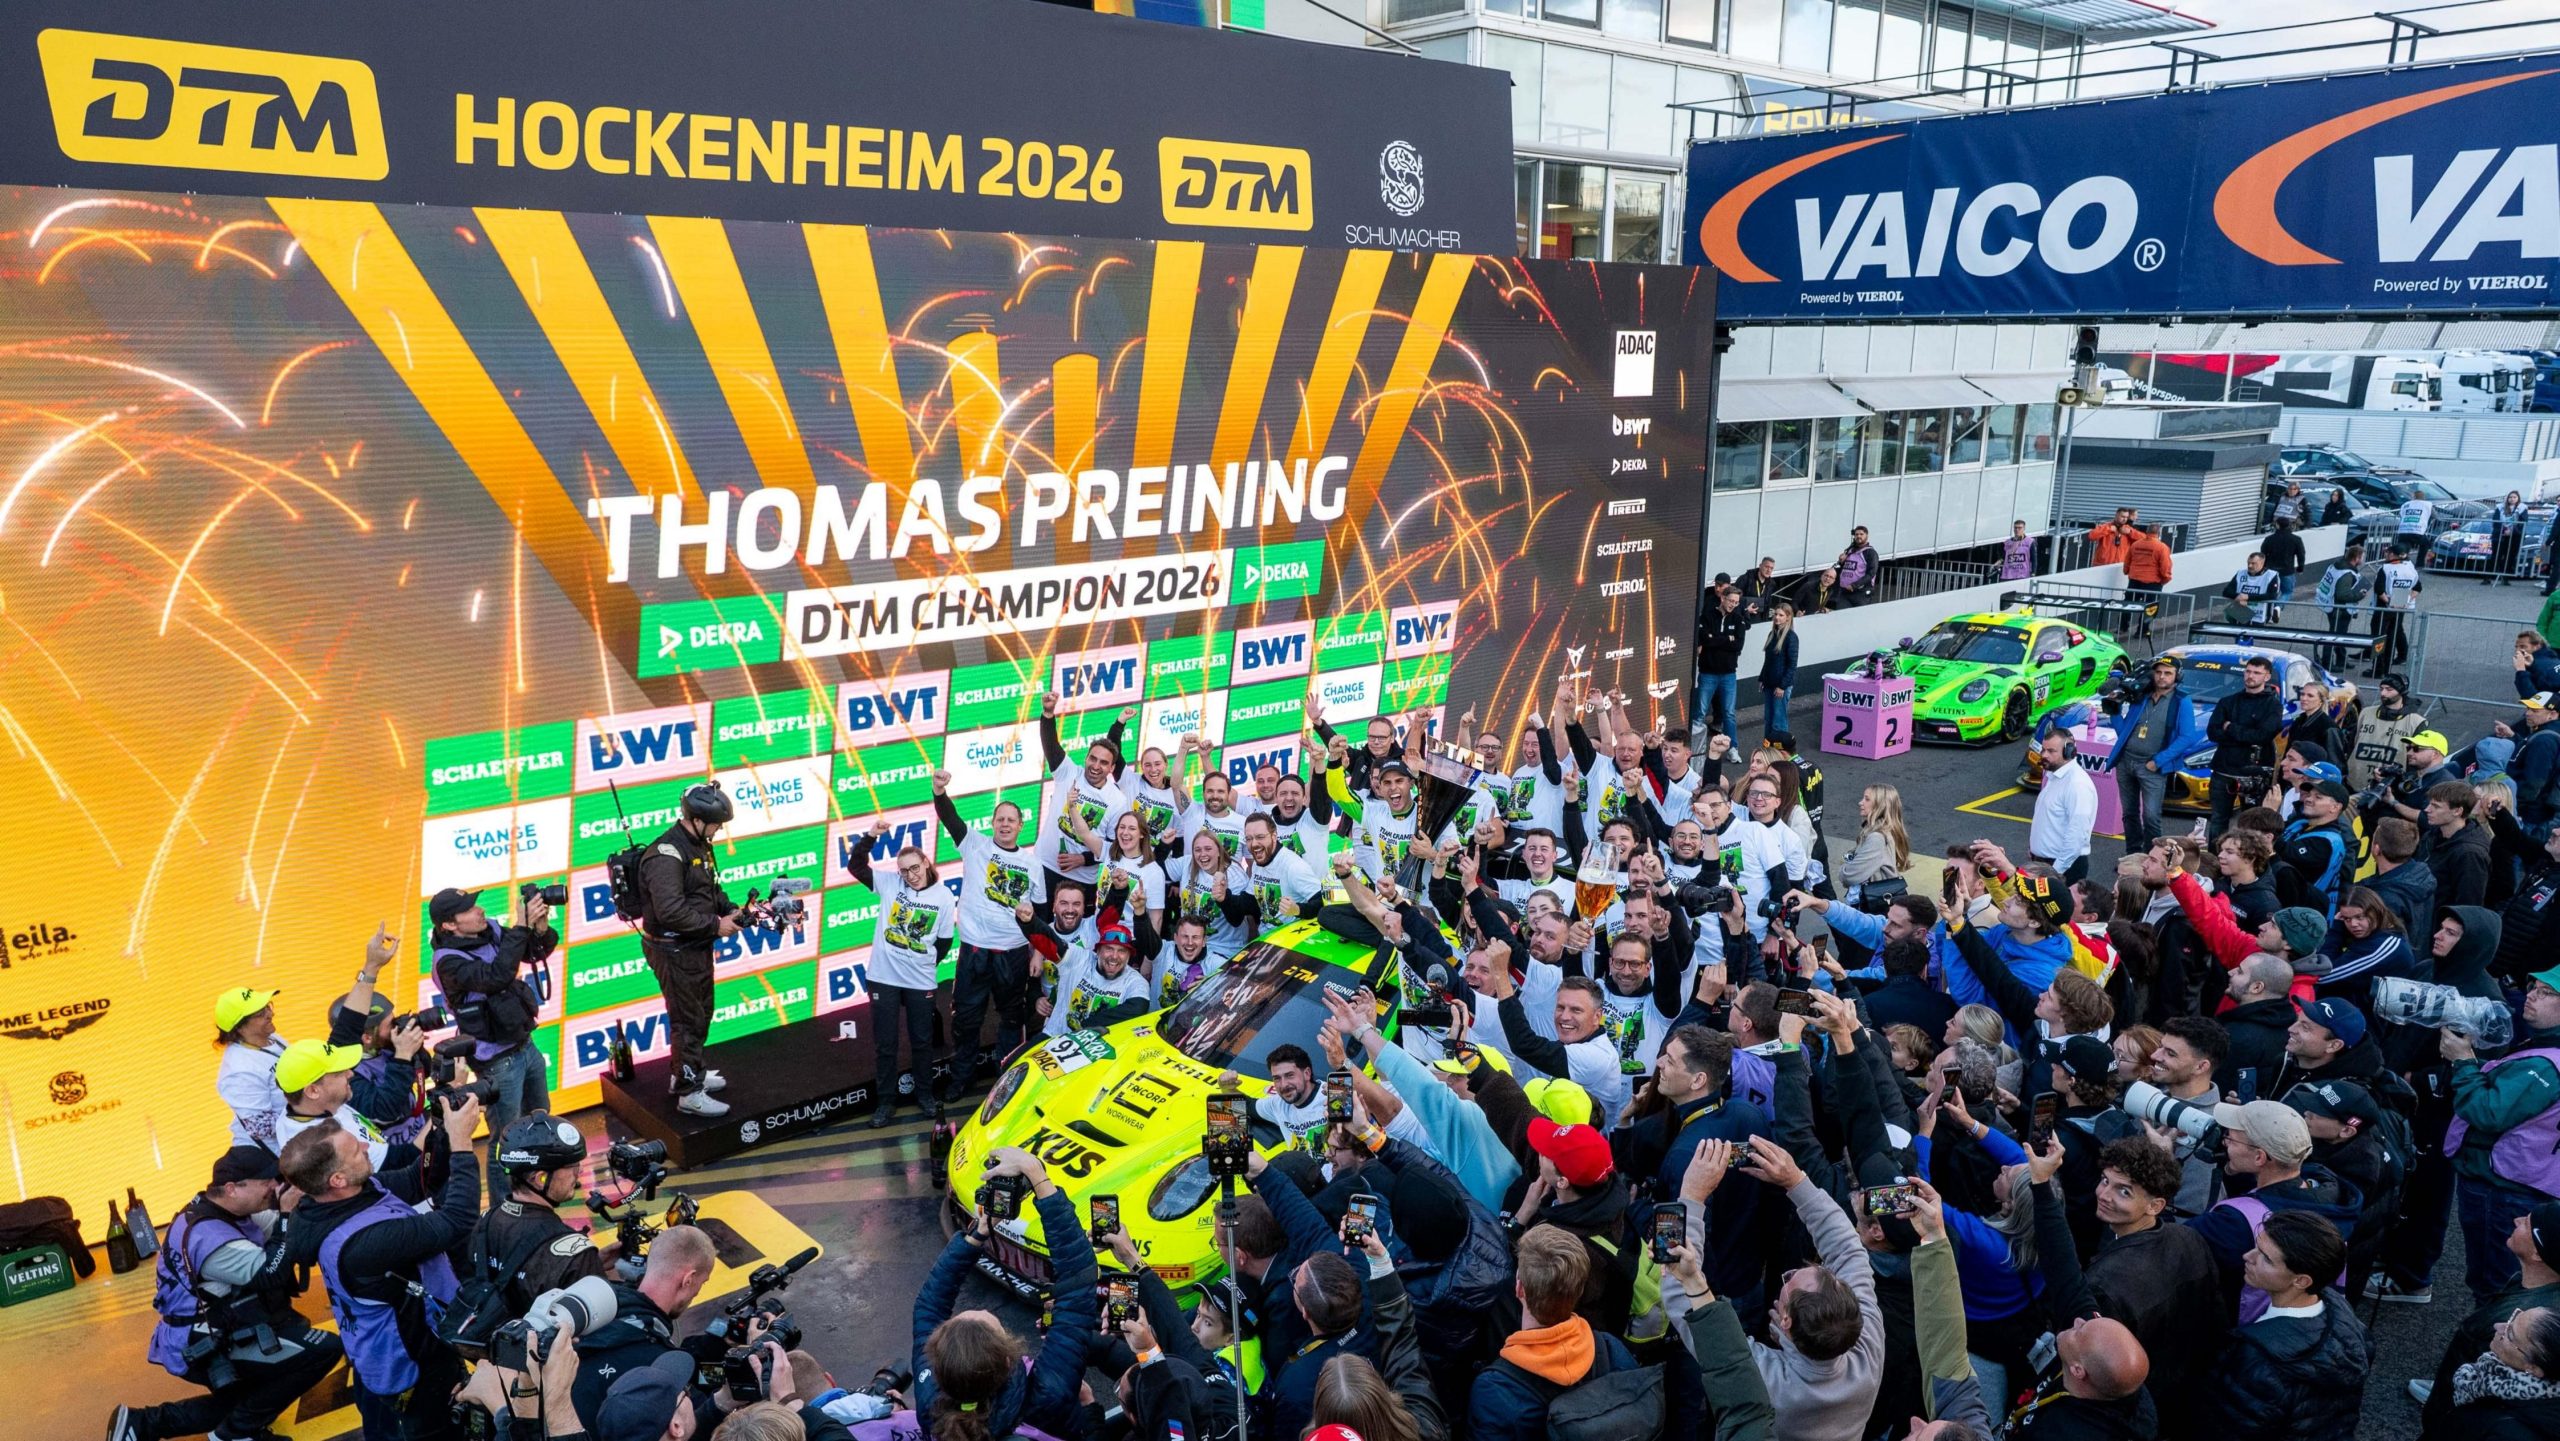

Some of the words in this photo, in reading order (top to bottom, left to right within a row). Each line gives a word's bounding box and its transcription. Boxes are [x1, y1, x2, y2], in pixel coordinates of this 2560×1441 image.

[82, 58, 358, 156] DTM
[455, 93, 965, 194] HOCKENHEIM
[978, 138, 1123, 205] 2026
[1176, 156, 1299, 214] DTM
[1345, 224, 1461, 249] SCHUMACHER
[1800, 292, 1841, 304] Powered
[1842, 292, 1854, 304] by
[1856, 290, 1904, 302] VIEROL
[2374, 276, 2427, 294] Powered
[2432, 275, 2463, 297] by
[2466, 274, 2548, 291] VIEROL
[1618, 334, 1654, 355] ADAC
[1623, 417, 1651, 435] BWT
[1621, 458, 1647, 472] DEKRA
[1608, 498, 1646, 516] PIRELLI
[588, 477, 1003, 585] THOMAS
[1019, 455, 1348, 544] PREINING
[1597, 538, 1653, 557] SCHAEFFLER
[1262, 559, 1310, 584] DEKRA
[2393, 579, 2413, 588] DTM
[1600, 578, 1646, 597] VIEROL
[801, 597, 899, 646] DTM
[912, 571, 1125, 634] CHAMPION
[1132, 562, 1221, 606] 2026
[689, 618, 763, 650] DEKRA
[1318, 630, 1383, 650] SCHAEFFLER
[1395, 612, 1452, 647] BWT
[1241, 633, 1306, 671] BWT
[1151, 653, 1227, 677] SCHAEFFLER
[2195, 662, 2222, 670] DTM
[1061, 657, 1138, 699] BWT
[1323, 681, 1365, 697] CHANGE
[1384, 673, 1447, 694] SCHAEFFLER
[953, 680, 1045, 707] SCHAEFFLER
[1332, 692, 1365, 706] WORLD
[1841, 691, 1875, 708] BWT
[1890, 688, 1912, 706] BWT
[2036, 686, 2046, 701] 90
[848, 685, 938, 731] BWT
[1159, 709, 1207, 726] CHANGE
[1230, 699, 1301, 722] SCHAEFFLER
[1932, 706, 1967, 716] VELTINS
[718, 712, 827, 742] SCHAEFFLER
[1169, 720, 1207, 735] WORLD
[588, 720, 699, 772] BWT
[966, 740, 1023, 760] CHANGE
[1428, 735, 1485, 771] DTM
[2358, 746, 2392, 763] DTM
[431, 750, 565, 786] SCHAEFFLER
[978, 752, 1023, 769] WORLD
[1228, 747, 1293, 786] BWT
[735, 777, 803, 801] CHANGE
[750, 791, 804, 810] WORLD
[578, 806, 686, 839] SCHAEFFLE
[454, 823, 538, 850] CHANGE
[473, 839, 539, 860] WORLD
[715, 851, 818, 883] CHAEFFLER
[12, 923, 77, 951] eila.
[1283, 965, 1320, 984] DTM
[38, 997, 112, 1023] LEGEND
[1052, 1038, 1082, 1064] 91
[1162, 1056, 1219, 1087] TRILU
[1126, 1082, 1167, 1105] TRICORP
[765, 1088, 868, 1130] SCHUMACHER
[1105, 1106, 1145, 1132] WORKWEAR
[620, 1186, 644, 1205] RONIN
[8, 1262, 60, 1286] VELTINS
